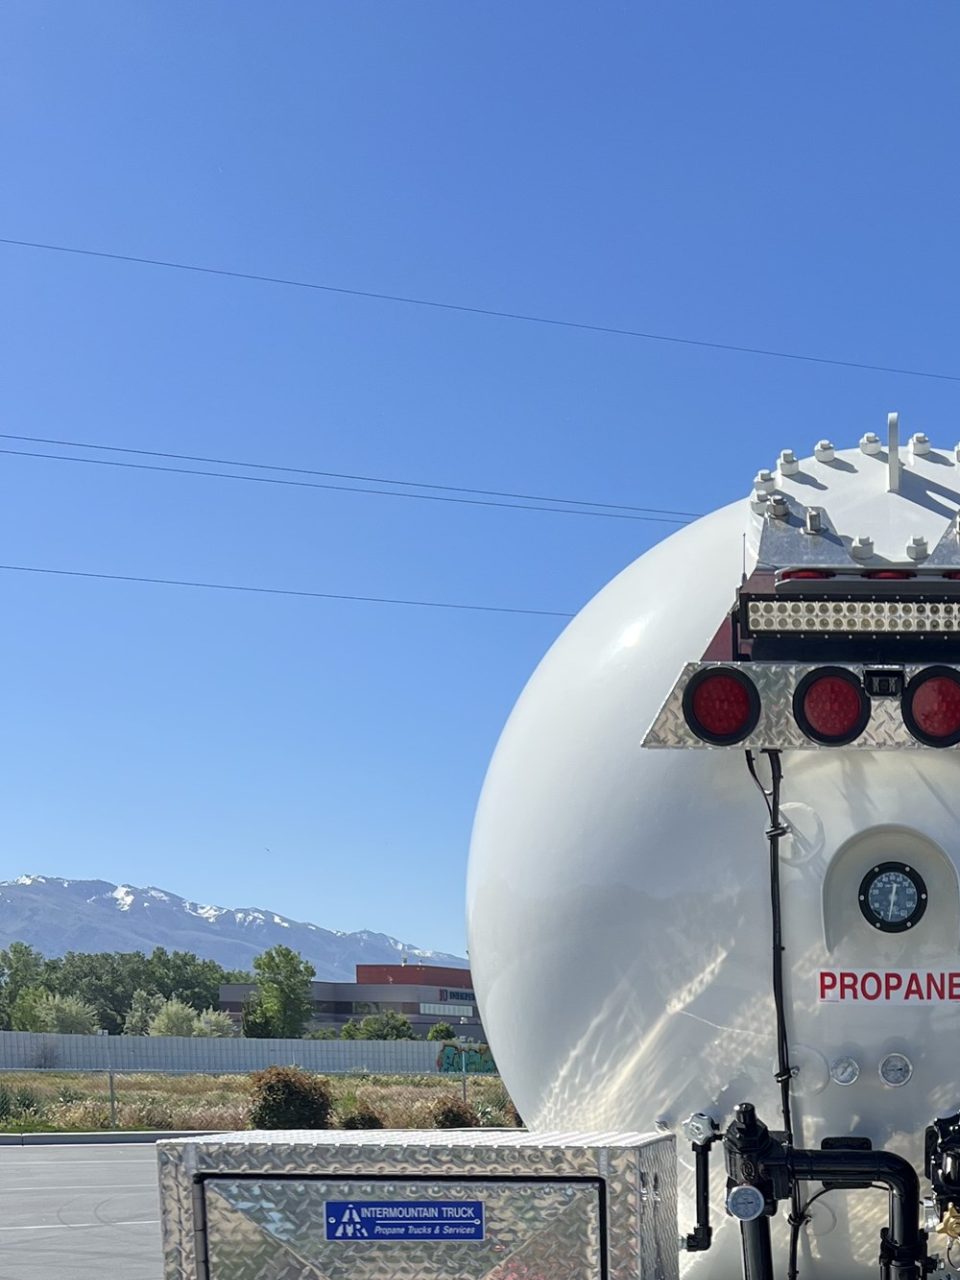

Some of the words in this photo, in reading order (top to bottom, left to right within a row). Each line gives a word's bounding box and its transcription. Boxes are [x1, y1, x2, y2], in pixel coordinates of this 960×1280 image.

[360, 1207, 439, 1218] INTERMOUNTAIN
[441, 1207, 475, 1218] TRUCK
[374, 1225, 405, 1236] Propane
[407, 1225, 432, 1234] Trucks
[433, 1225, 440, 1234] &
[442, 1225, 476, 1234] Services
